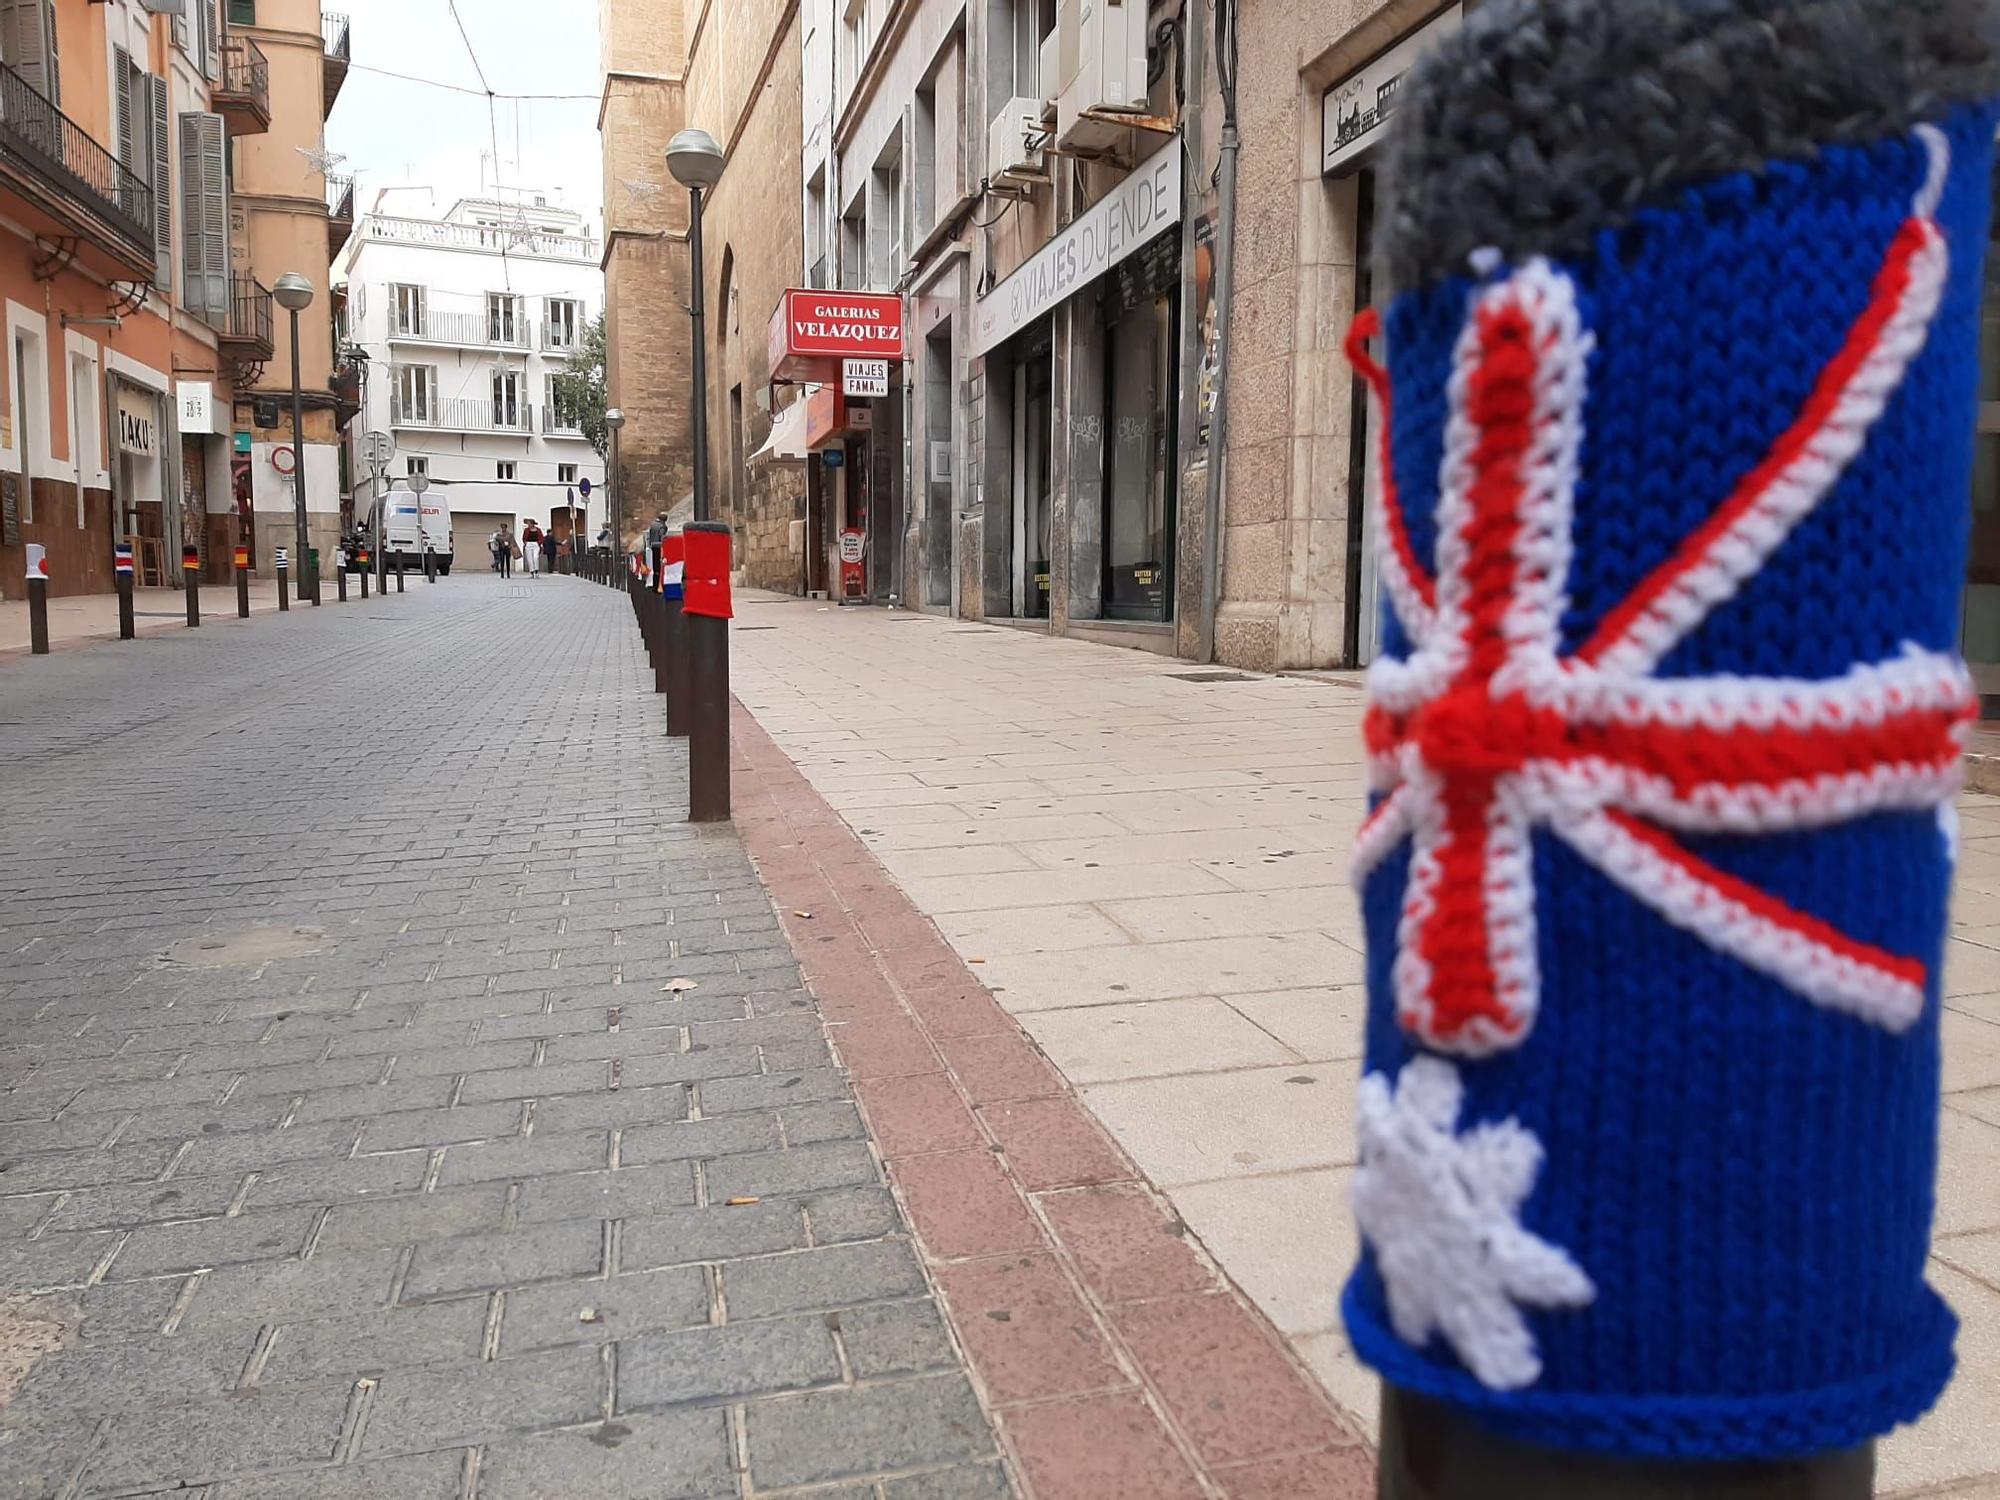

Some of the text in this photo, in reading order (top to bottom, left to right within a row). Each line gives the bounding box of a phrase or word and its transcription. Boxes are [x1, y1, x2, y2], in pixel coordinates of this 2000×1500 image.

[1022, 238, 1076, 313] VIAJES
[1081, 161, 1168, 274] DUENDE
[815, 305, 880, 319] GALERIAS
[795, 322, 900, 341] VELAZQUEZ
[848, 363, 884, 377] VIAJES
[849, 381, 875, 393] FAMA
[120, 409, 149, 450] TAKU
